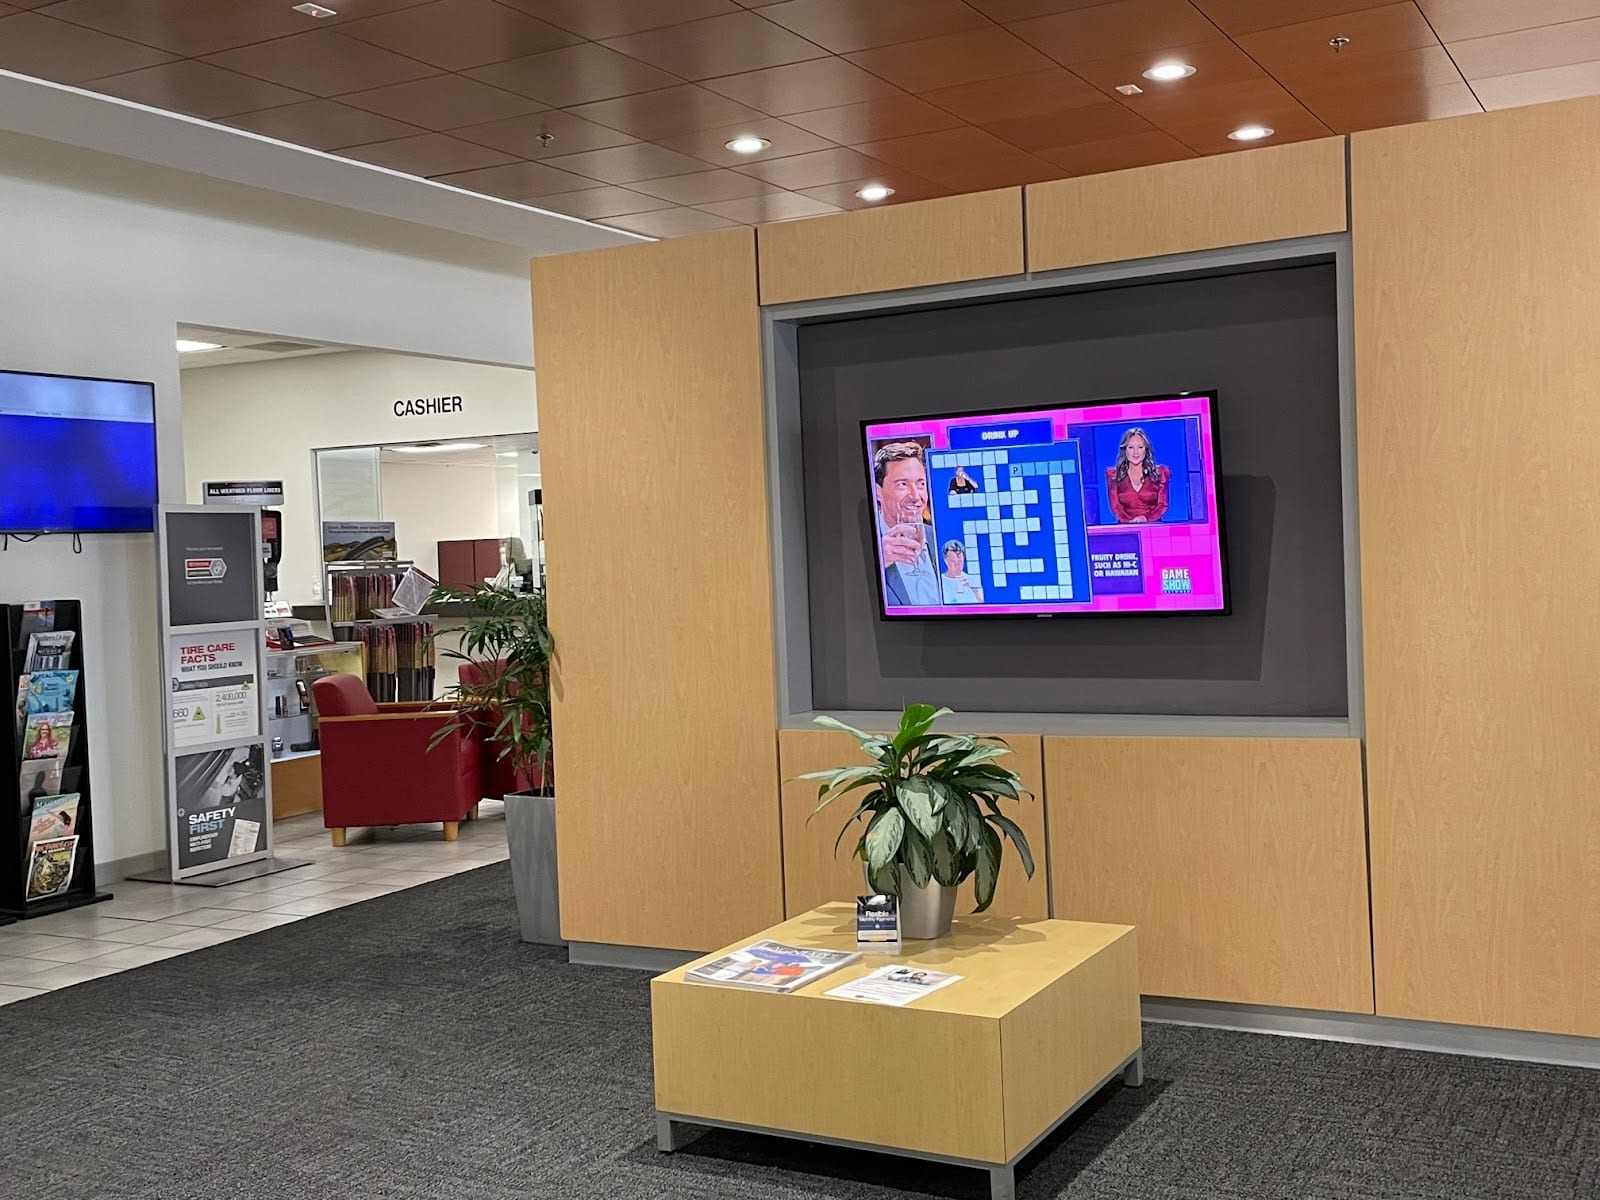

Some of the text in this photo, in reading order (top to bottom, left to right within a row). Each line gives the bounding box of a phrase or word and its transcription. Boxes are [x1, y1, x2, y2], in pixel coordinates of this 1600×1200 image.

[394, 396, 462, 416] CASHIER
[982, 429, 1019, 440] DRINK UP
[1012, 466, 1018, 475] P
[1112, 561, 1122, 569] AS
[1094, 569, 1104, 577] OR
[1161, 569, 1190, 580] GAME
[1163, 579, 1191, 590] SHOW
[180, 643, 235, 655] TIRE CARE
[181, 653, 216, 664] FACTS
[181, 665, 196, 673] WHAT
[208, 662, 227, 670] SHOULD
[189, 807, 236, 825] SAFETY
[190, 819, 225, 835] FIRST
